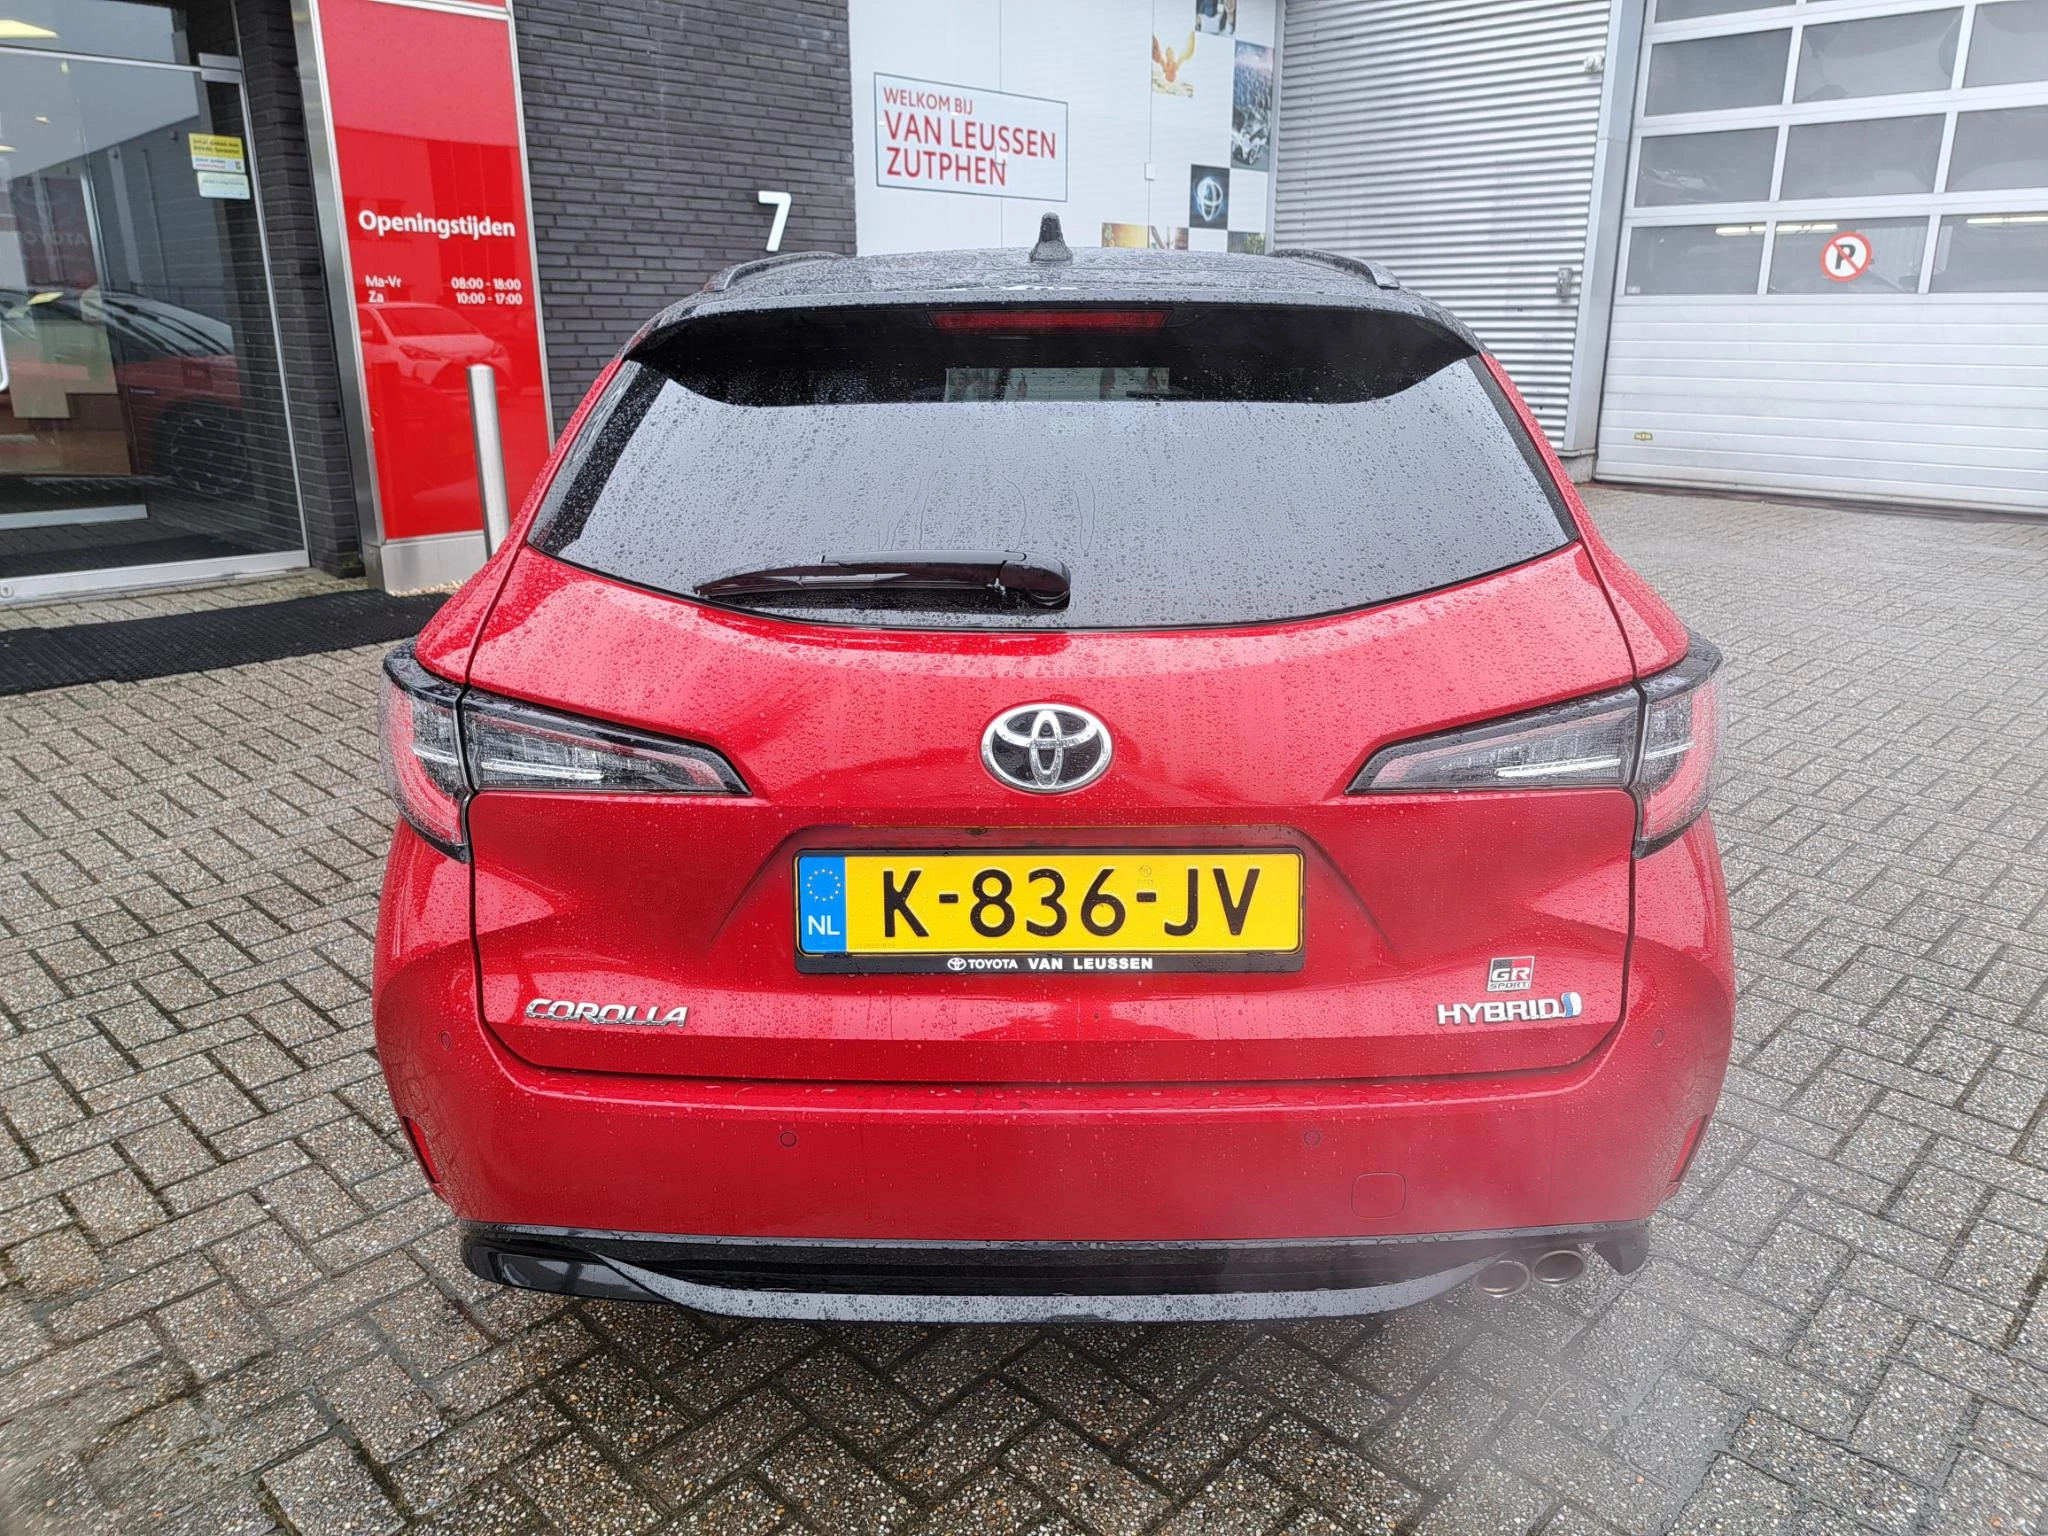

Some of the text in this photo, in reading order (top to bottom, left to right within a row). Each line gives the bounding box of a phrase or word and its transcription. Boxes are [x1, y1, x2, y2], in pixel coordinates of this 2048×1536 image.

[883, 87, 973, 115] WELKOM BIJ
[884, 109, 1057, 160] VAN LEUSSEN
[886, 146, 1006, 186] ZUTPHEN
[358, 209, 516, 240] Openingstijden
[757, 190, 792, 252] 7
[1835, 244, 1856, 270] P
[365, 275, 402, 288] Ma-Vr
[451, 277, 484, 290] 08:00
[493, 278, 522, 290] 18:00
[368, 290, 384, 303] Za
[456, 292, 485, 304] 10:00
[495, 293, 523, 305] 17:00
[882, 867, 1261, 938] K-836-JV
[807, 915, 840, 936] NL
[968, 958, 1153, 970] TOYOTA VAN LEUSSEN
[1491, 967, 1531, 982] GR
[1489, 981, 1529, 990] SPORT
[525, 998, 689, 1027] COROLLA
[1437, 999, 1561, 1025] HYBRID
